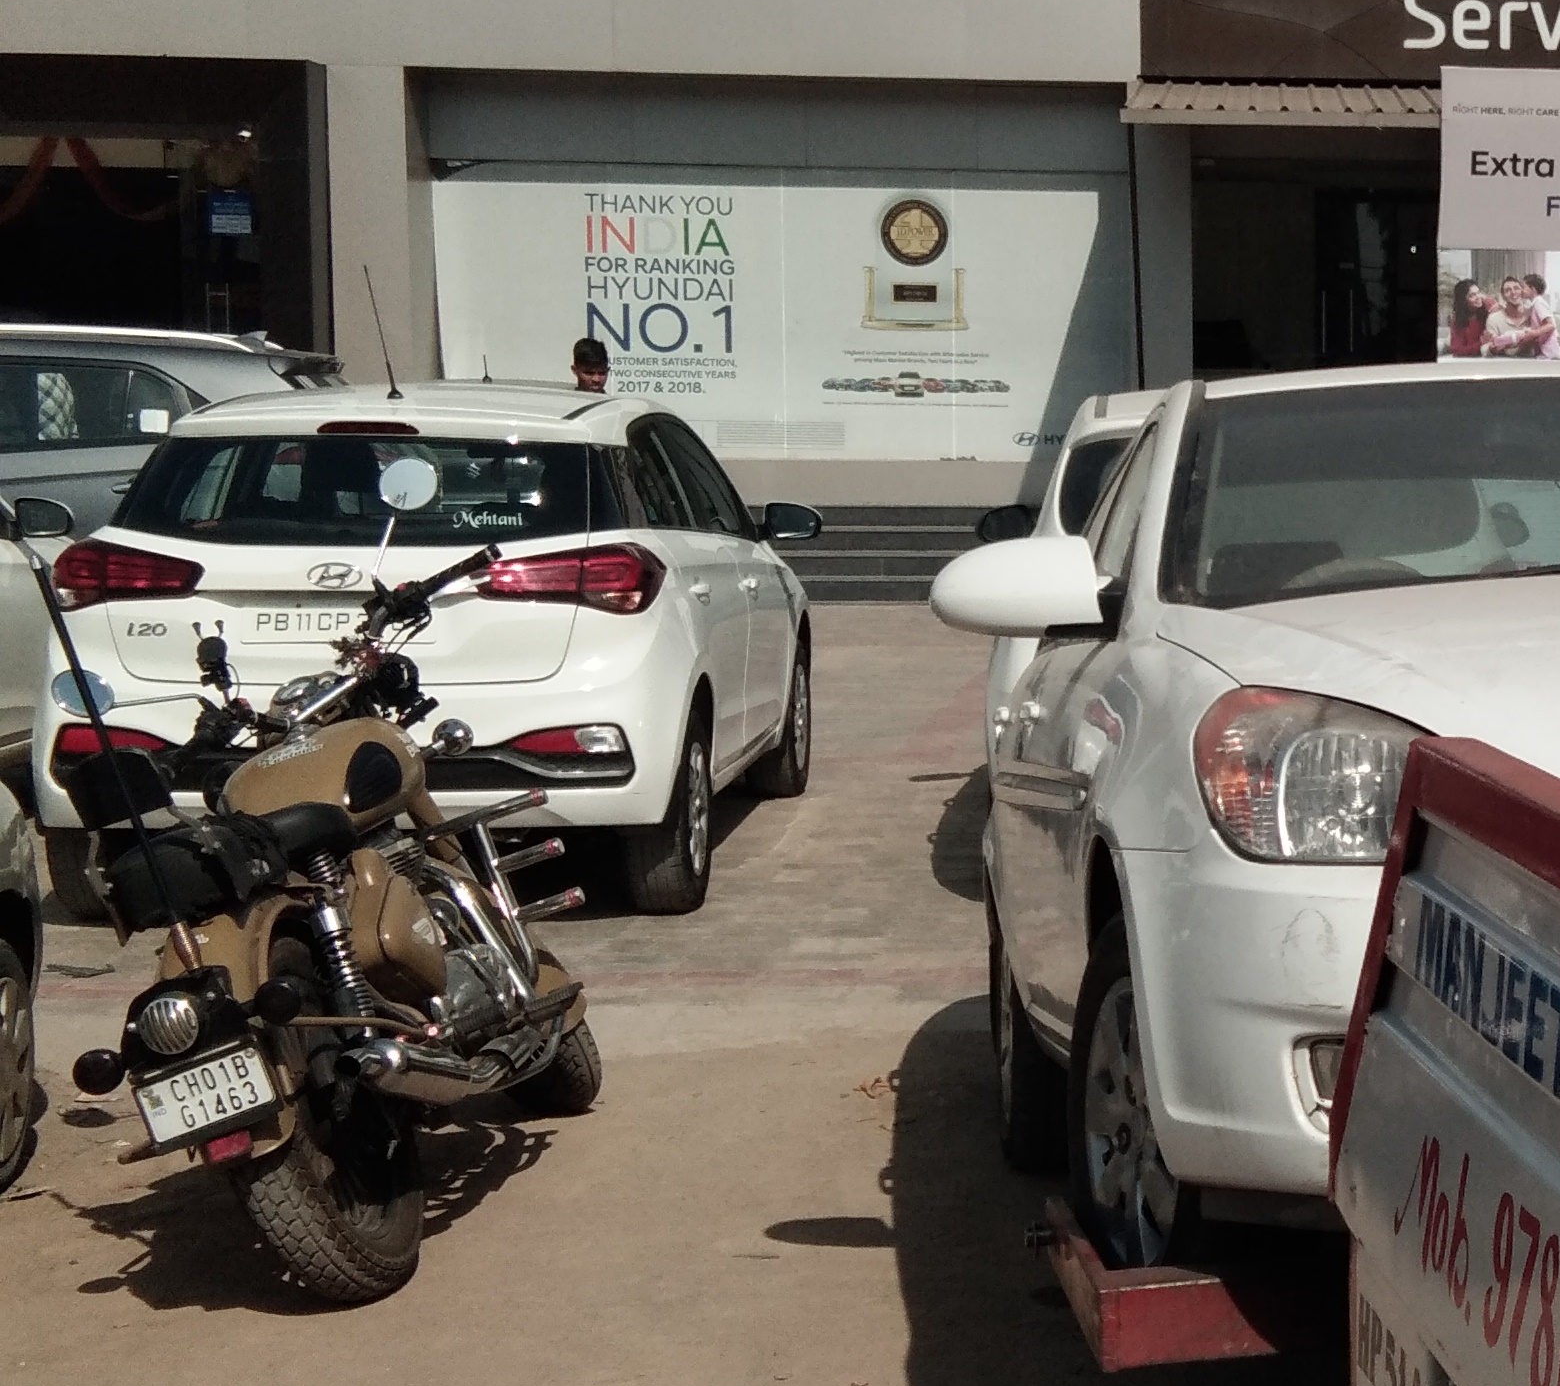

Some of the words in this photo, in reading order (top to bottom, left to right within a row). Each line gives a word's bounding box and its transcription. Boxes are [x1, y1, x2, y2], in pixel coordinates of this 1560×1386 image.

[1536, 108, 1559, 117] CARE
[1470, 150, 1555, 178] Extra
[584, 193, 675, 215] THANK
[679, 196, 733, 216] YOU
[586, 215, 730, 256] INDIA
[584, 256, 629, 274] FOR
[634, 257, 735, 276] RANKING
[587, 275, 733, 302] HYUNDAI
[586, 301, 733, 354] NO.1
[608, 357, 659, 367] USTOMER
[661, 358, 737, 369] SATISFACTION,
[633, 370, 703, 380] CONSECUTIVE
[704, 370, 736, 380] YEARS
[617, 381, 651, 393] 2017
[653, 381, 664, 393] &
[453, 511, 523, 529] Mehtani
[181, 1081, 259, 1128] G1463
[1395, 1134, 1471, 1326] Mob.
